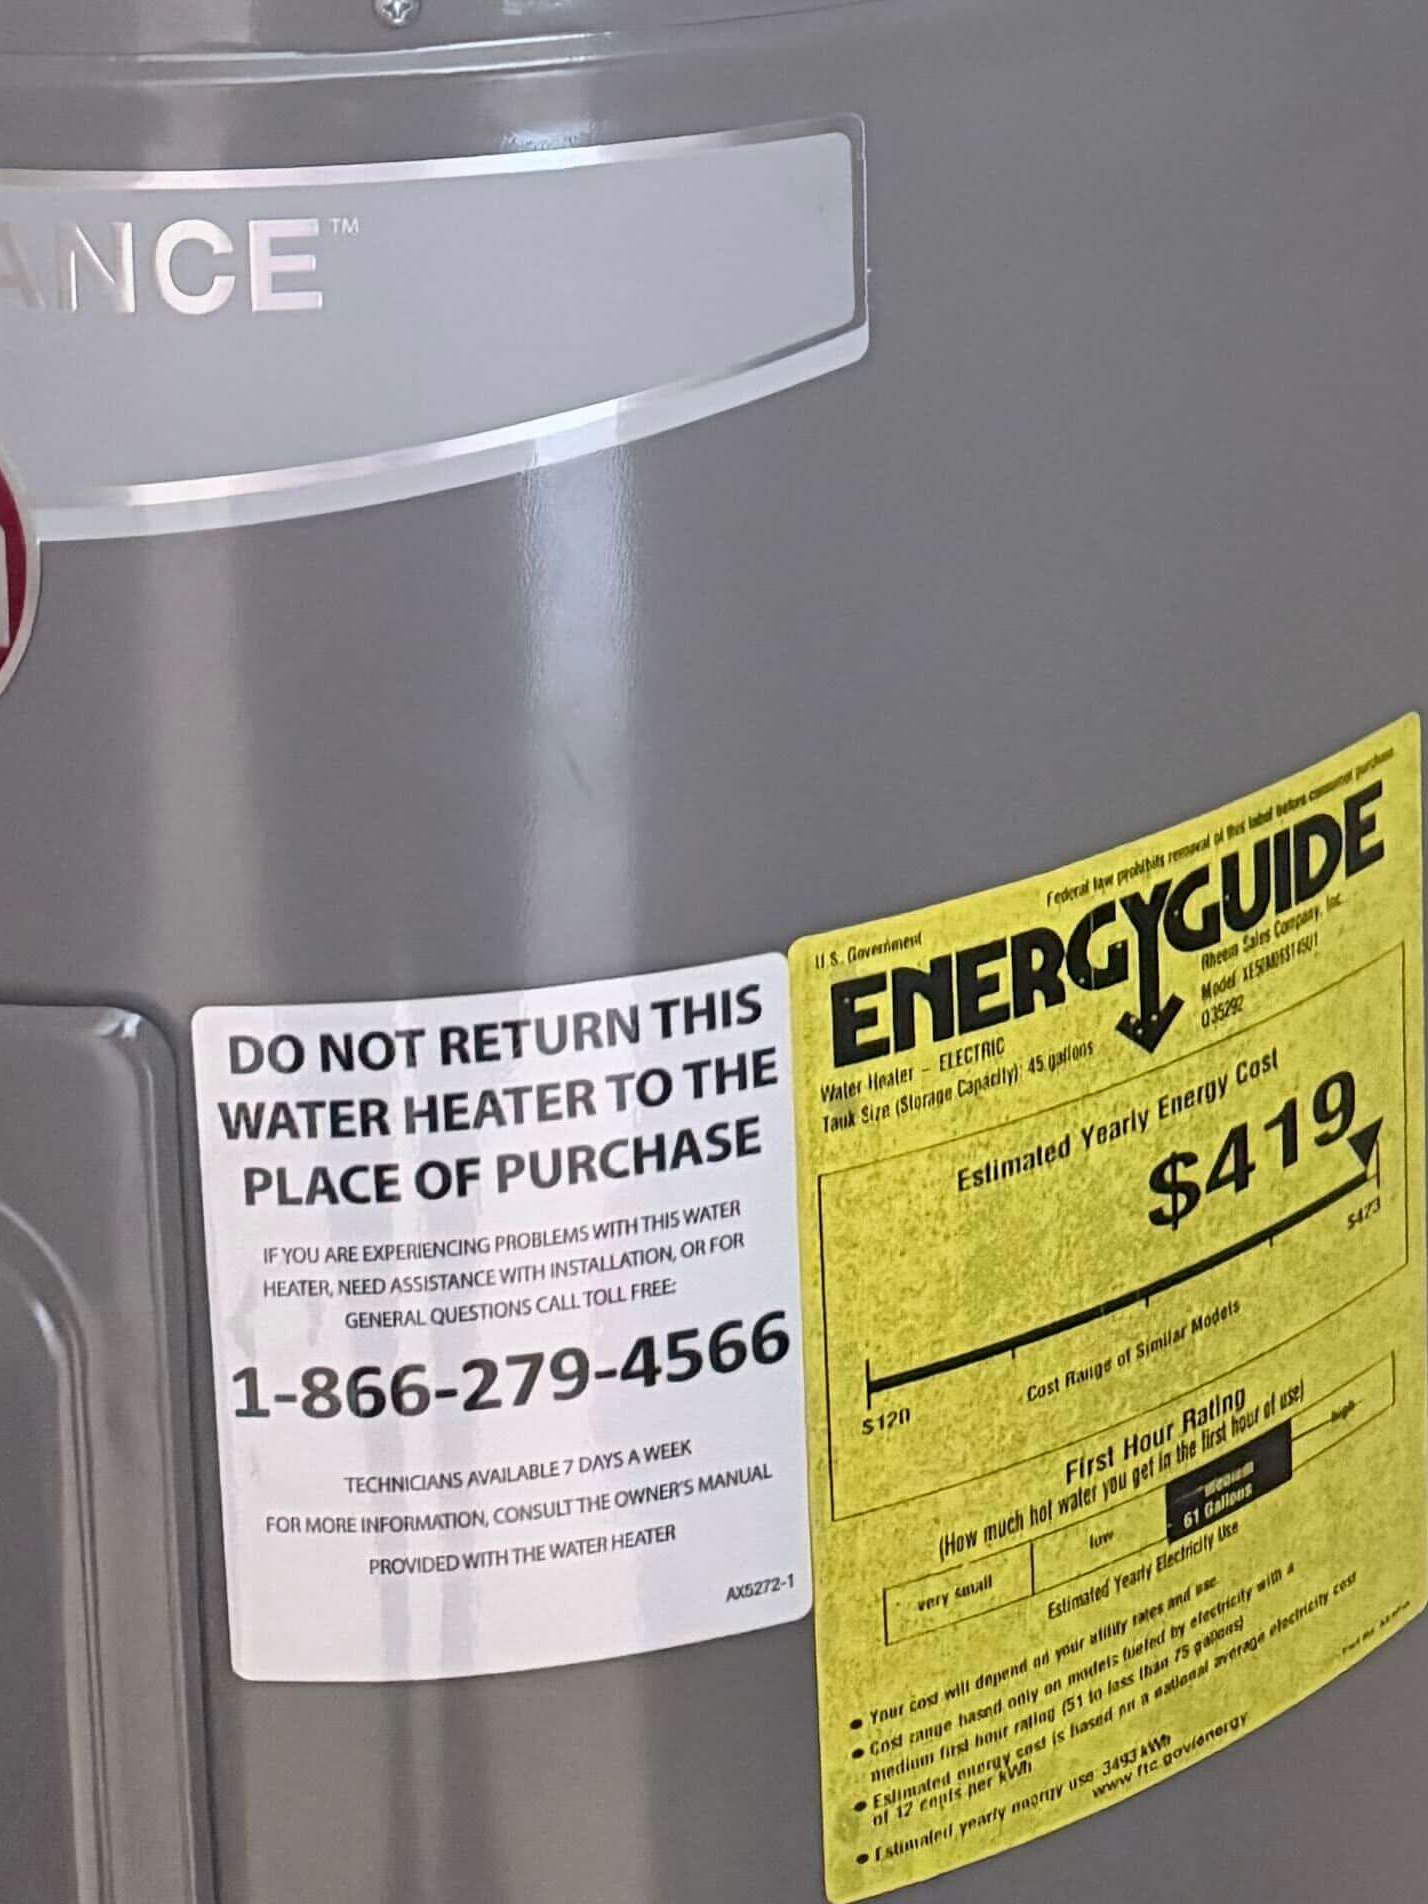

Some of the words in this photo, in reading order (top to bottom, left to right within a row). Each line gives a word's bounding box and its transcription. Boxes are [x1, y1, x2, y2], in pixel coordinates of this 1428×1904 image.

[1046, 879, 1090, 909] Federal
[1092, 873, 1115, 892] law
[1116, 853, 1167, 887] prohibits
[1167, 833, 1211, 865] removal
[829, 779, 1385, 1069] ENERGYGUIDE
[846, 929, 923, 966] Government
[1242, 926, 1272, 954] Sales
[1200, 968, 1238, 1003] Model
[229, 1033, 305, 1075] DO
[320, 1028, 426, 1073] NOT
[439, 1004, 640, 1067] RETURN
[650, 983, 763, 1039] THIS
[217, 1099, 392, 1141] WATER
[404, 1078, 597, 1136] HEATER
[605, 1066, 674, 1111] TO
[682, 1046, 779, 1100] THE
[820, 1079, 863, 1105] Water
[867, 1065, 915, 1092] Heater
[938, 1035, 1006, 1073] ELECTRIC
[822, 1112, 857, 1135] Tank
[895, 1084, 954, 1118] (Storage
[1027, 1054, 1046, 1075] 45
[1047, 1038, 1095, 1075] gallons
[956, 1131, 1072, 1193] Estimated
[1080, 1106, 1150, 1151] Yearly
[1157, 1074, 1230, 1120] Energy
[1234, 1046, 1279, 1086] Cost
[1147, 1069, 1357, 1232] $419
[243, 1163, 402, 1207] PLACE
[414, 1157, 482, 1201] OF
[496, 1115, 763, 1194] PURCHASE
[263, 1245, 281, 1266] IF
[281, 1244, 322, 1265] YOU
[324, 1242, 360, 1264] ARE
[362, 1235, 492, 1263] EXPERIENCING
[493, 1223, 591, 1256] PROBLEMS
[591, 1216, 640, 1246] WITH
[639, 1209, 681, 1237] THIS
[681, 1199, 742, 1233] WATER
[263, 1277, 335, 1300] HEATER,
[337, 1276, 387, 1297] NEED
[388, 1268, 497, 1296] ASSISTANCE
[497, 1262, 547, 1287] WITH
[548, 1246, 678, 1283] INSTALLATION,
[679, 1238, 707, 1259] OR
[708, 1231, 746, 1255] FOR
[344, 1308, 427, 1330] GENERAL
[429, 1298, 533, 1328] QUESTIONS
[534, 1291, 581, 1314] CALL
[580, 1284, 628, 1309] TOLL
[630, 1277, 677, 1303] FREE:
[231, 1309, 791, 1419] 1-866-279-4566
[1026, 1378, 1061, 1404] Cost
[1063, 1357, 1113, 1390] Range
[1116, 1346, 1132, 1366] of
[1136, 1325, 1187, 1358] Similar
[1190, 1297, 1242, 1338] Models
[343, 1471, 464, 1495] TECHNICIANS
[466, 1459, 561, 1489] AVAILABLE
[562, 1459, 574, 1476] 7
[578, 1451, 625, 1474] DAYS
[627, 1448, 641, 1467] A
[643, 1438, 693, 1465] WEEK
[1064, 1442, 1115, 1486] First
[1122, 1421, 1175, 1462] Hour
[1181, 1386, 1247, 1435] Rating
[265, 1515, 302, 1535] FOR
[304, 1515, 357, 1535] MORE
[360, 1510, 489, 1535] INFORMATION,
[492, 1498, 575, 1527] CONSULT
[574, 1491, 612, 1515] THE
[613, 1477, 695, 1511] OWNER'S
[697, 1462, 774, 1496] MANUAL
[938, 1527, 978, 1564] (How
[982, 1505, 1026, 1545] much
[1028, 1497, 1054, 1527] hot
[1057, 1481, 1099, 1515] water
[1100, 1469, 1128, 1506] you
[1131, 1455, 1157, 1495] get
[1175, 1440, 1198, 1469] the
[1200, 1423, 1228, 1459] first
[1230, 1408, 1261, 1441] hour
[1262, 1396, 1277, 1423] of
[1182, 1508, 1201, 1531] 61
[1203, 1481, 1254, 1521] Gallons
[369, 1555, 460, 1577] PROVIDED
[461, 1550, 510, 1571] WITH
[511, 1545, 547, 1565] THE
[548, 1535, 609, 1563] WATER
[609, 1523, 678, 1556] HEATER
[725, 1572, 796, 1603] AX5272-1
[916, 1590, 950, 1613] very
[1088, 1528, 1115, 1551] low
[1047, 1579, 1112, 1621] Estimated
[1113, 1561, 1154, 1592] Yearly
[1155, 1534, 1215, 1574] Electricity
[1216, 1520, 1240, 1543] Use
[1189, 1586, 1253, 1630] electricity
